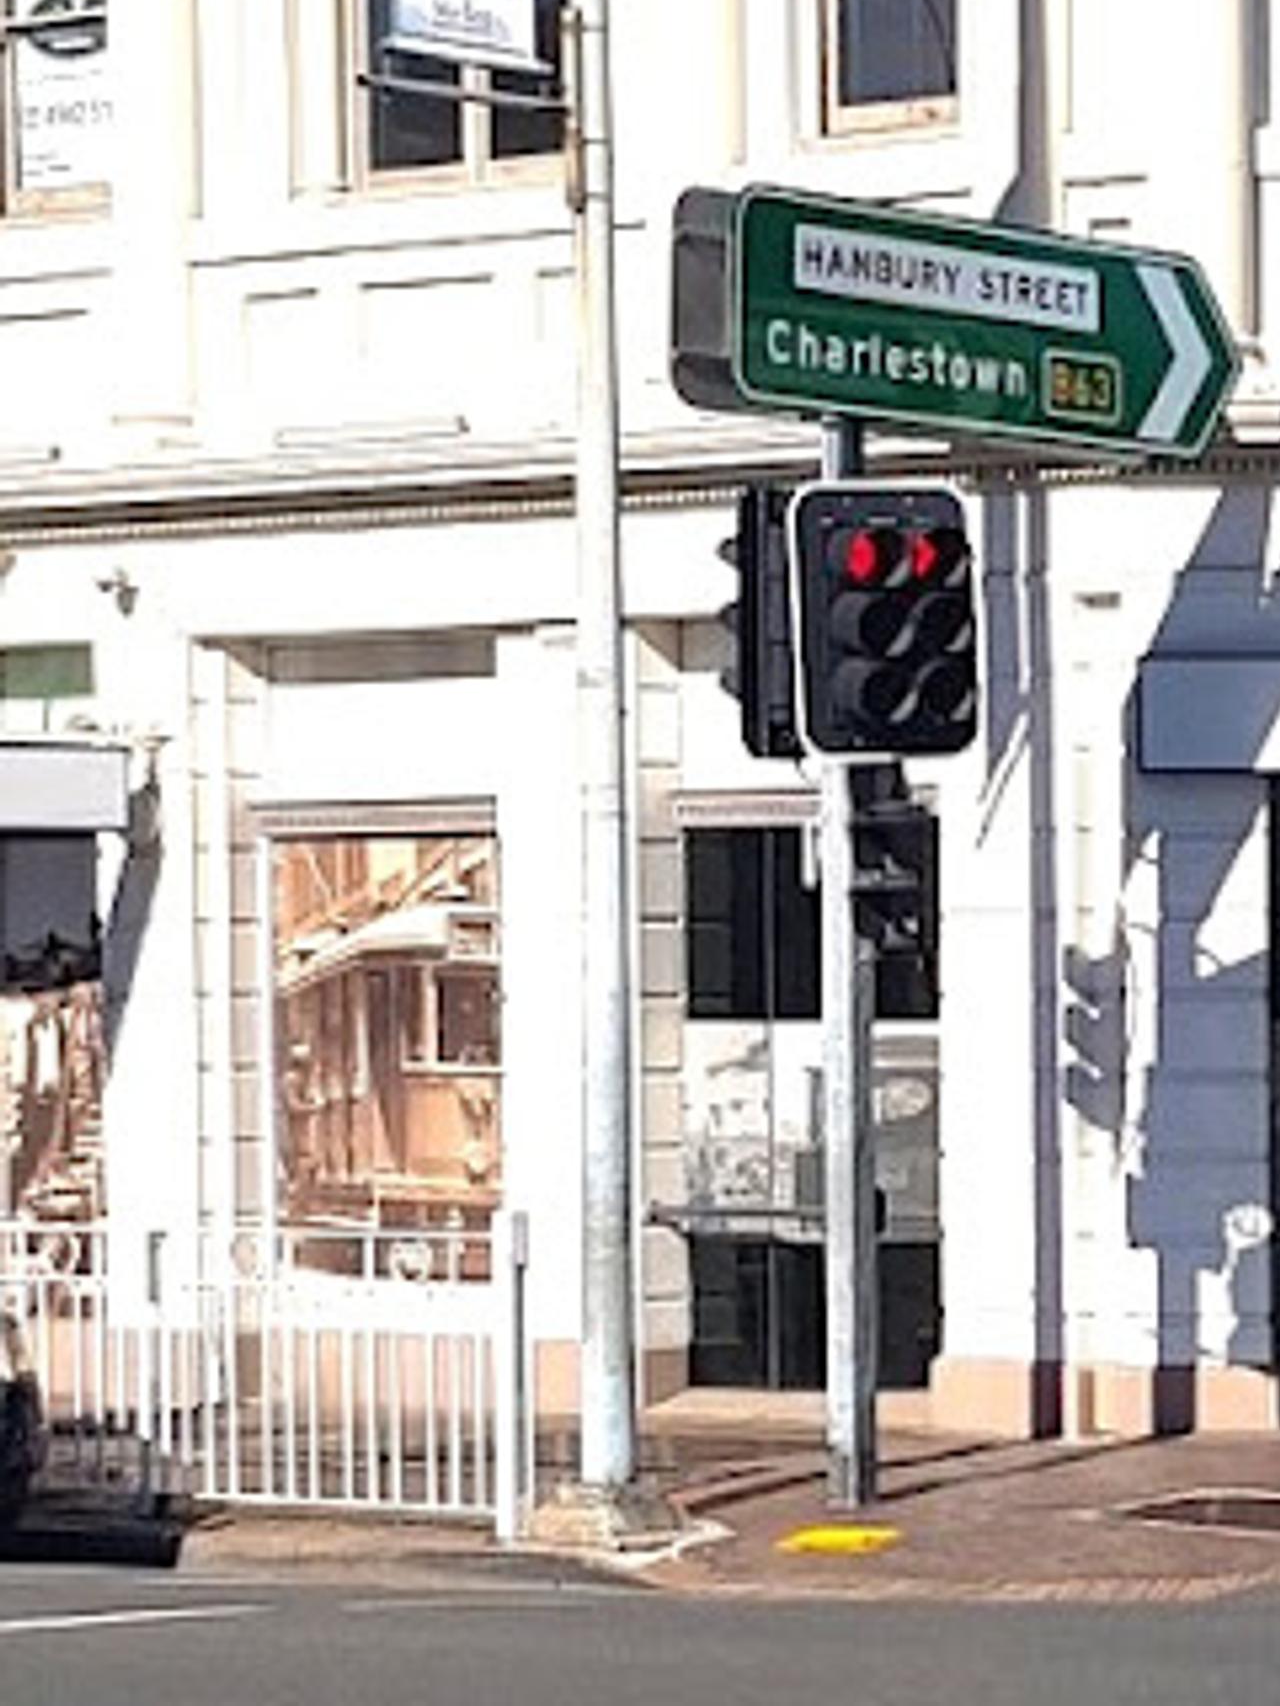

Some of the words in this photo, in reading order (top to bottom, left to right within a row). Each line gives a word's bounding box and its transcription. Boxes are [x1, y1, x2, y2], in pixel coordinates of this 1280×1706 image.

[803, 241, 962, 293] HANBURY
[980, 276, 1089, 316] STREET
[767, 319, 1027, 397] Charlestown
